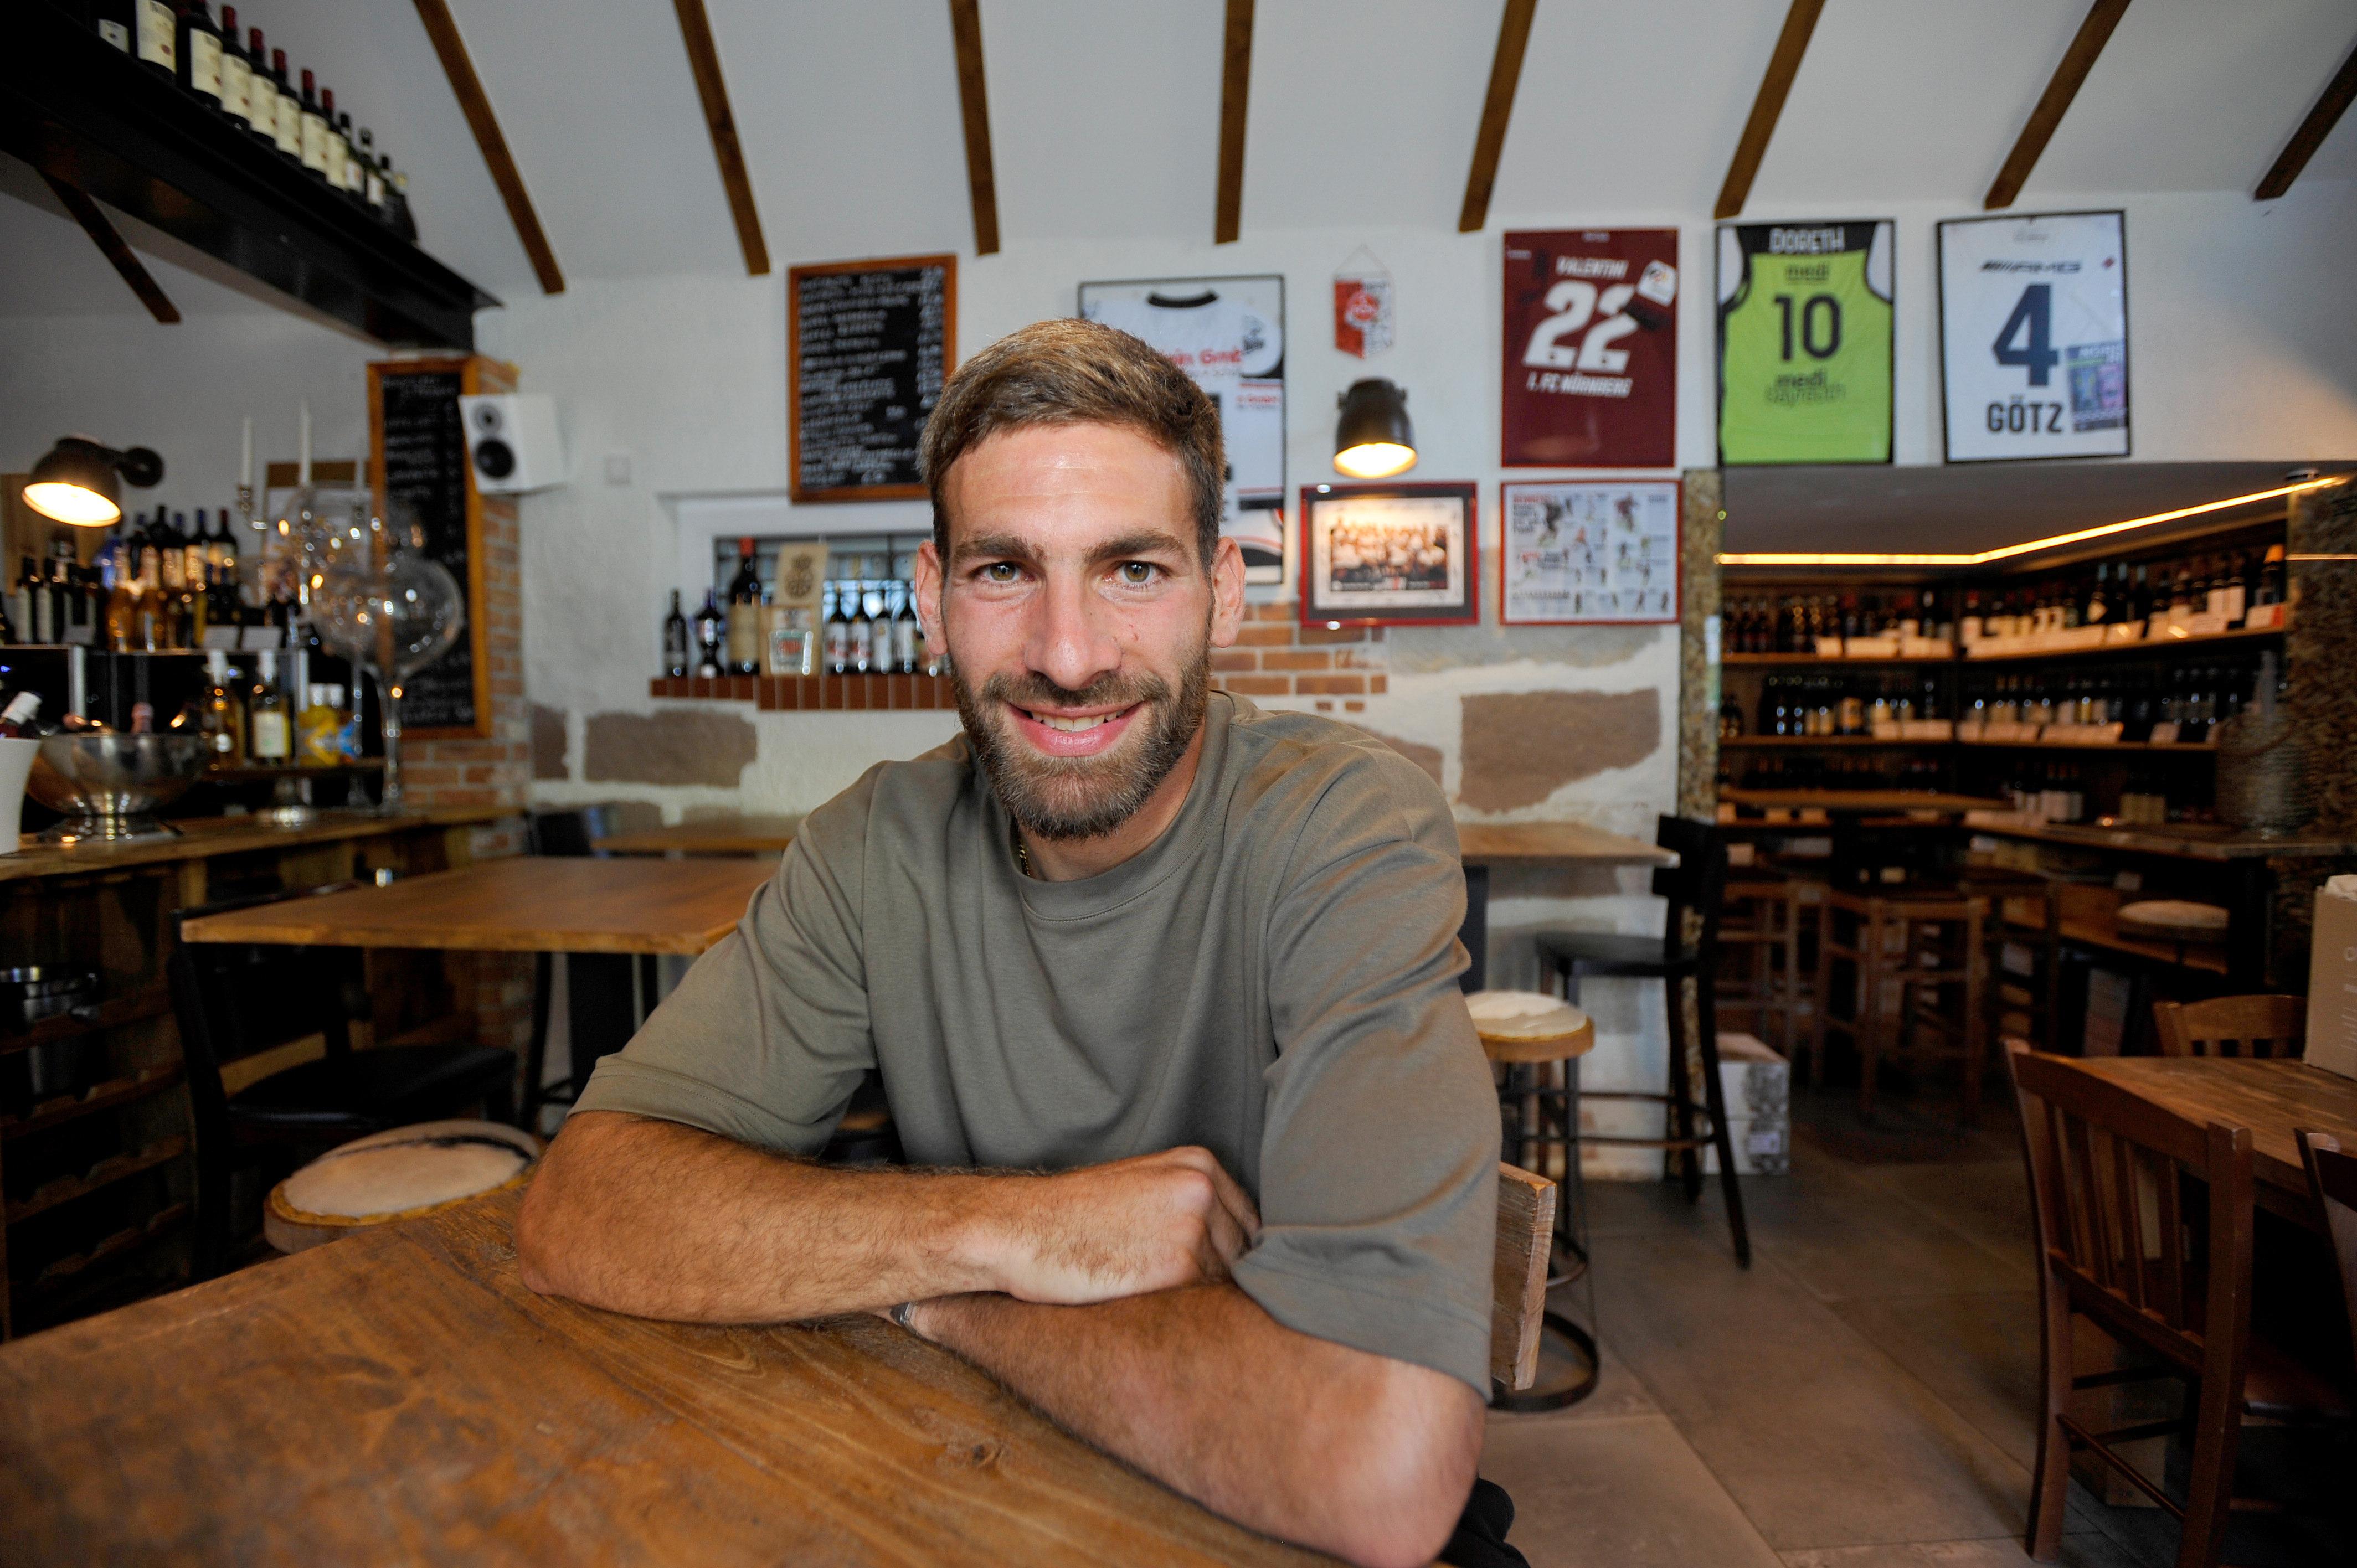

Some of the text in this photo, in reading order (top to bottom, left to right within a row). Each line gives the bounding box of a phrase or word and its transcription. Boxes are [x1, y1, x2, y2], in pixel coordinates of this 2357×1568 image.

[1769, 226, 1845, 254] DORETH
[1523, 281, 1639, 374] 22
[1774, 295, 1840, 360] 10
[1993, 285, 2059, 386] 4
[1987, 393, 2063, 433] GÖTZ
